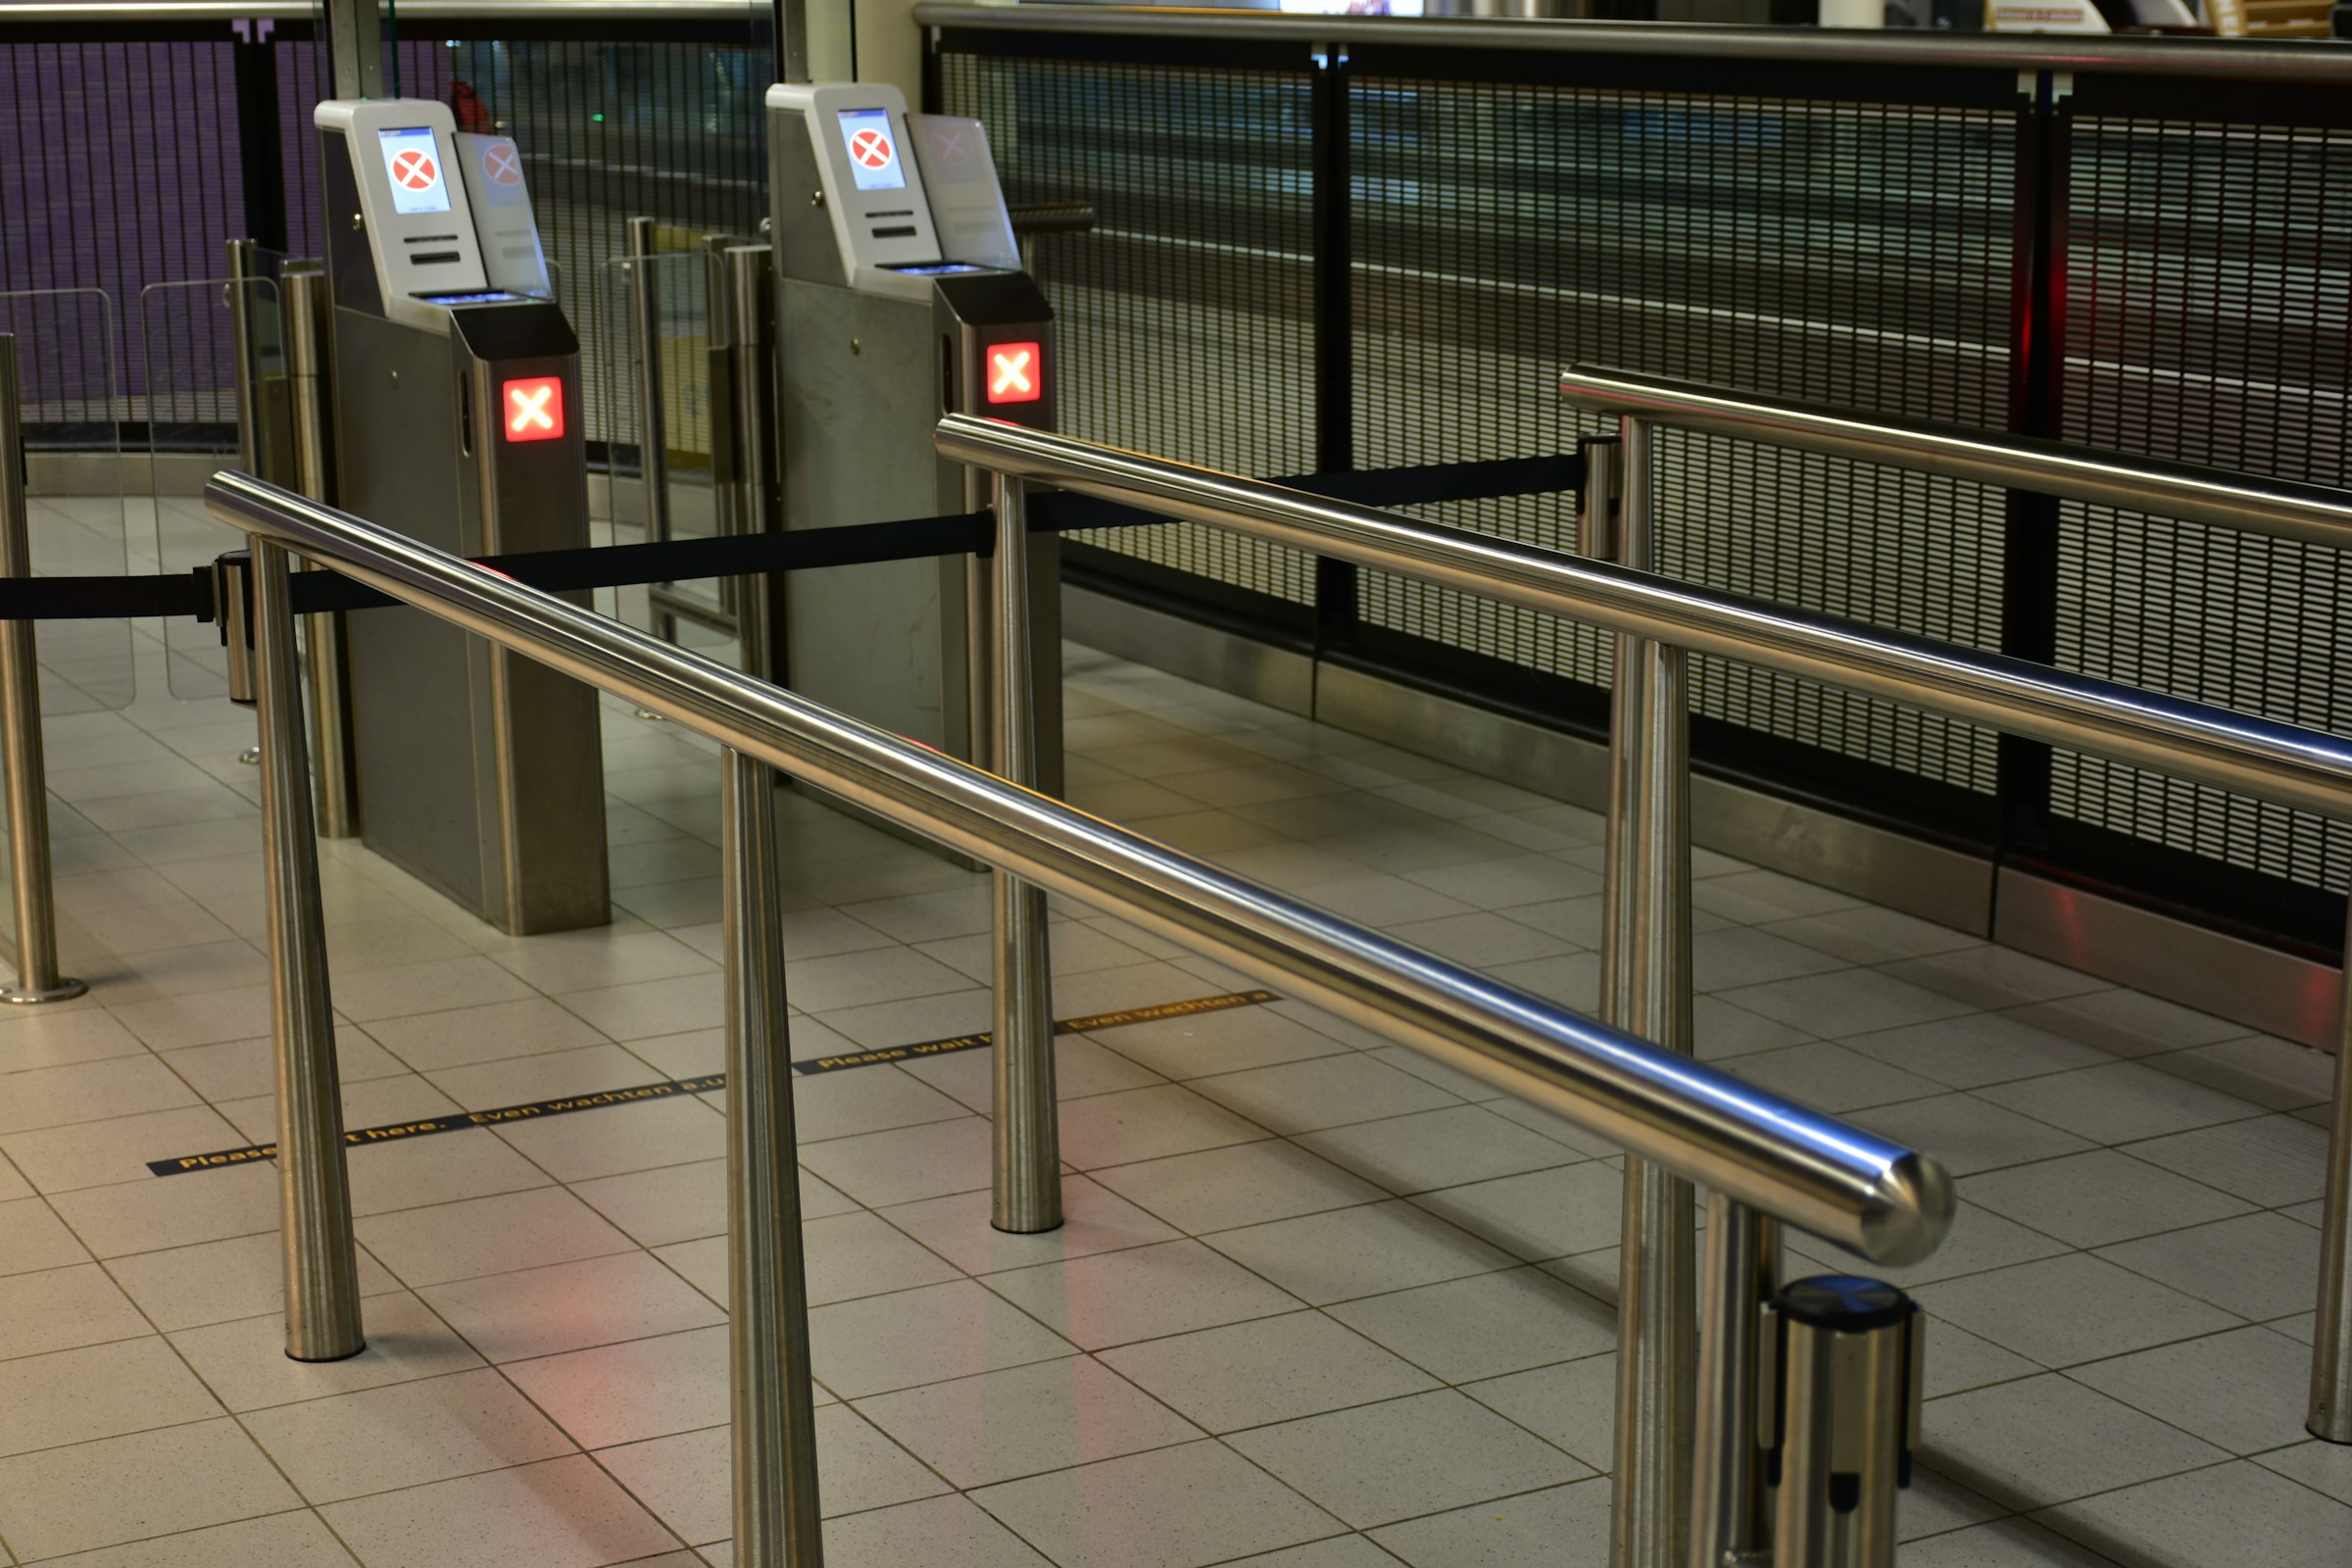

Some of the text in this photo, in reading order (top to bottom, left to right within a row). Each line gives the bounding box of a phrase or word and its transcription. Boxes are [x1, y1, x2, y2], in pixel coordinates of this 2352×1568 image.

[1066, 1012, 1132, 1029] Even
[815, 1048, 908, 1069] Please
[911, 1035, 978, 1054] wait
[467, 1105, 541, 1124] Even
[546, 1085, 674, 1111] wachten
[365, 1121, 447, 1140] here.
[179, 1147, 276, 1169] Please
